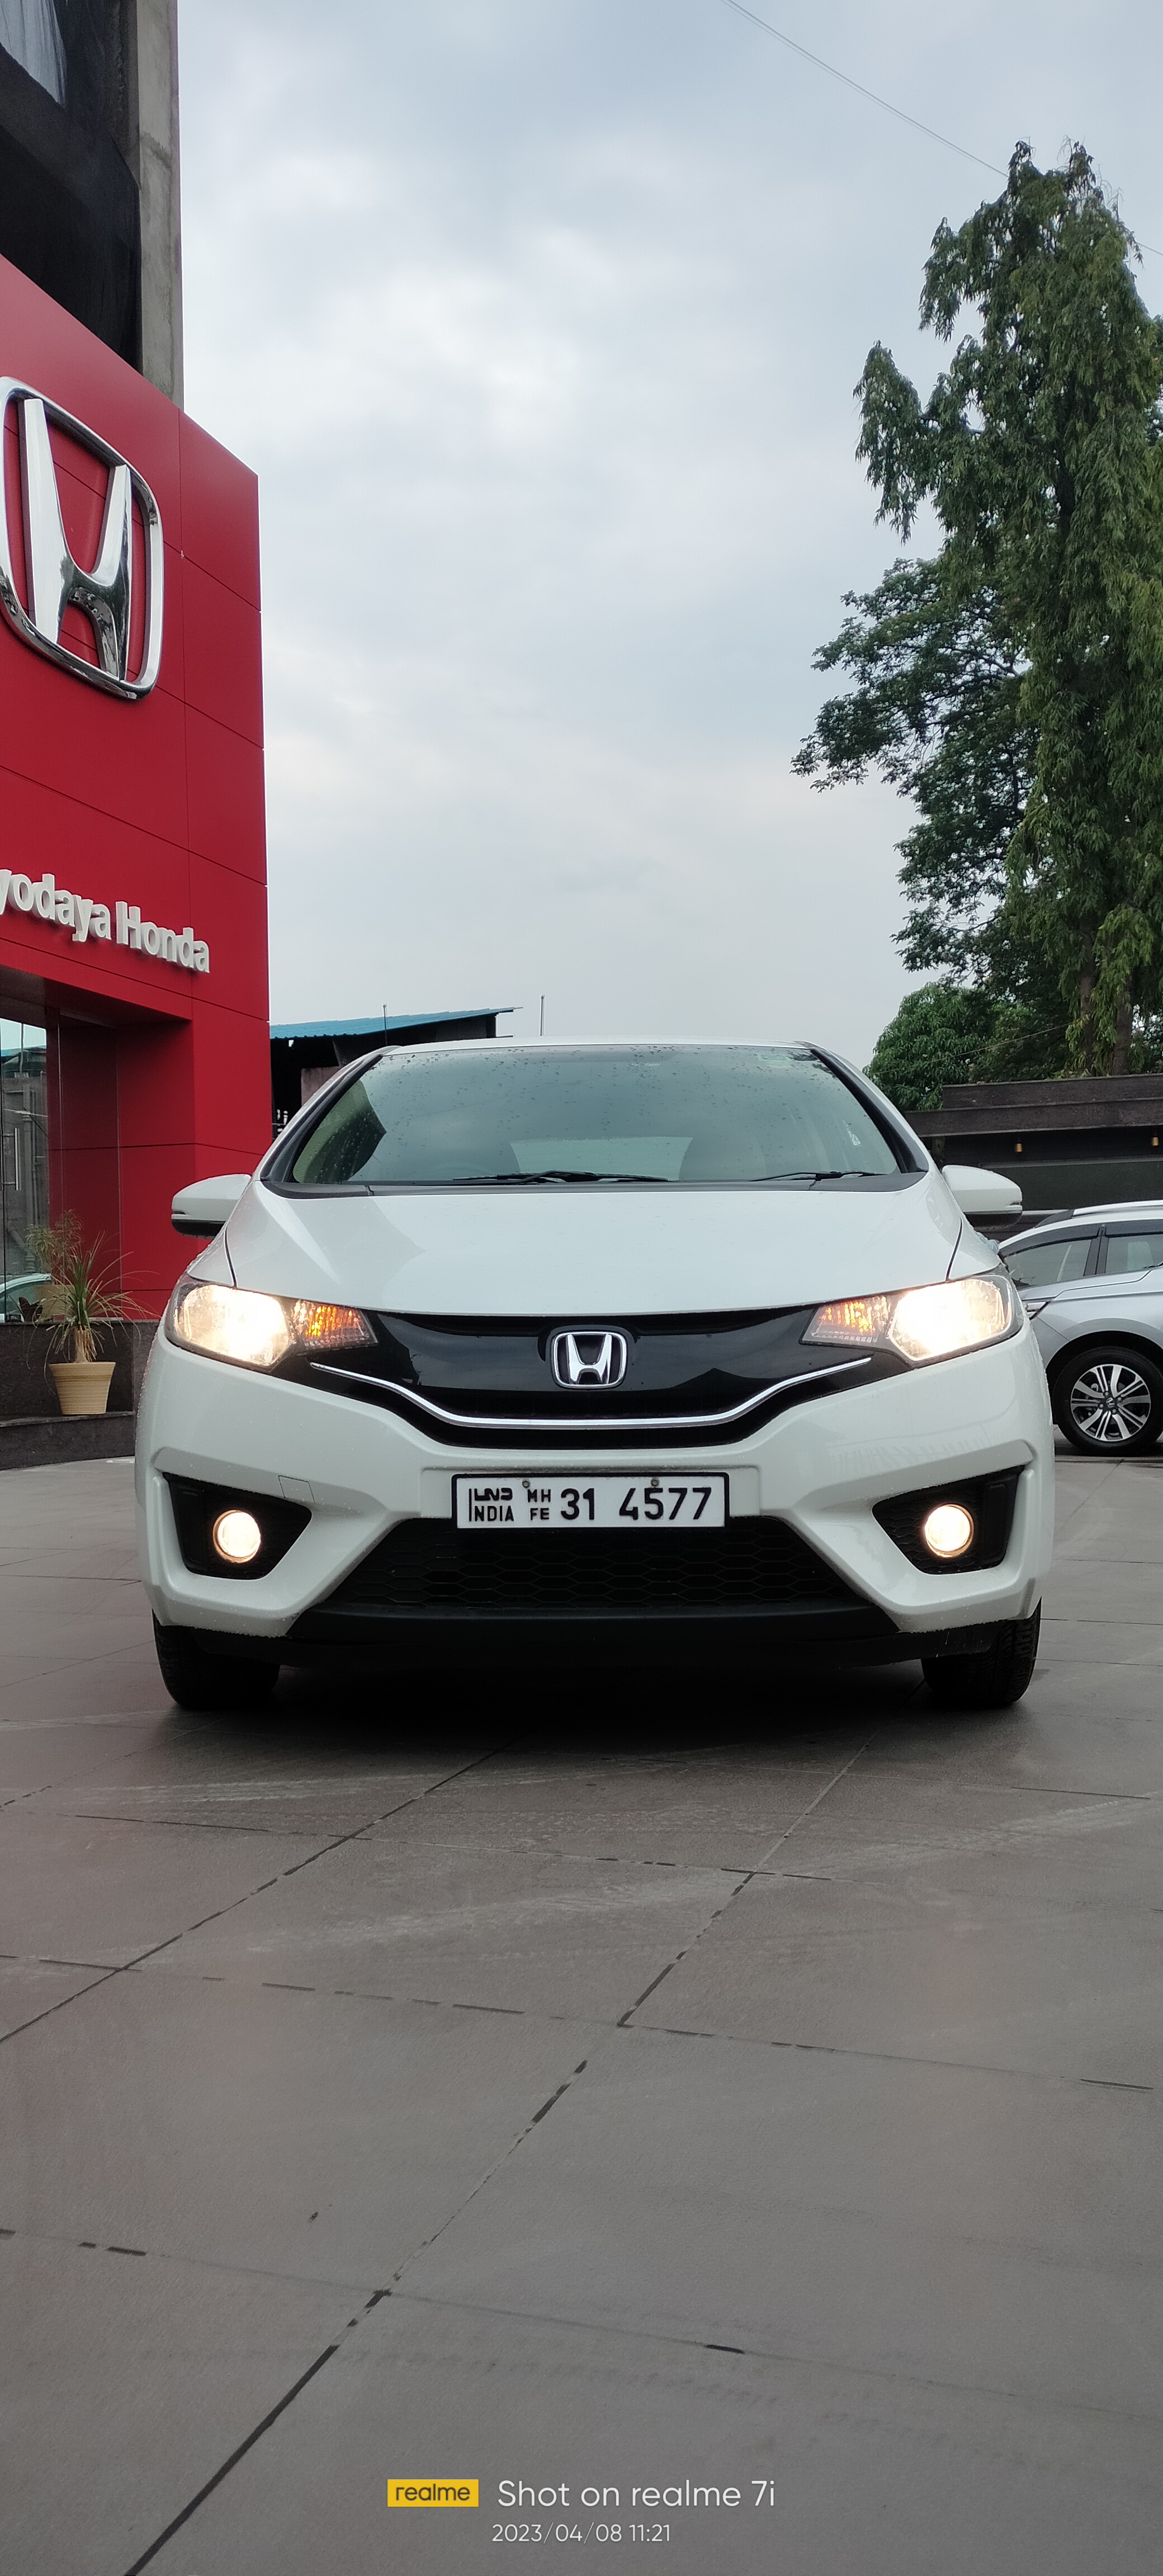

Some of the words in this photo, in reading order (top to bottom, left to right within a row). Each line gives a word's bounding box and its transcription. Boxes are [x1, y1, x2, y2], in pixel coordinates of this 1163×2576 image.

[115, 901, 210, 973] Honda
[527, 1489, 551, 1503] MH
[560, 1488, 595, 1521] 31
[619, 1487, 712, 1521] 4577
[530, 1507, 550, 1521] FE
